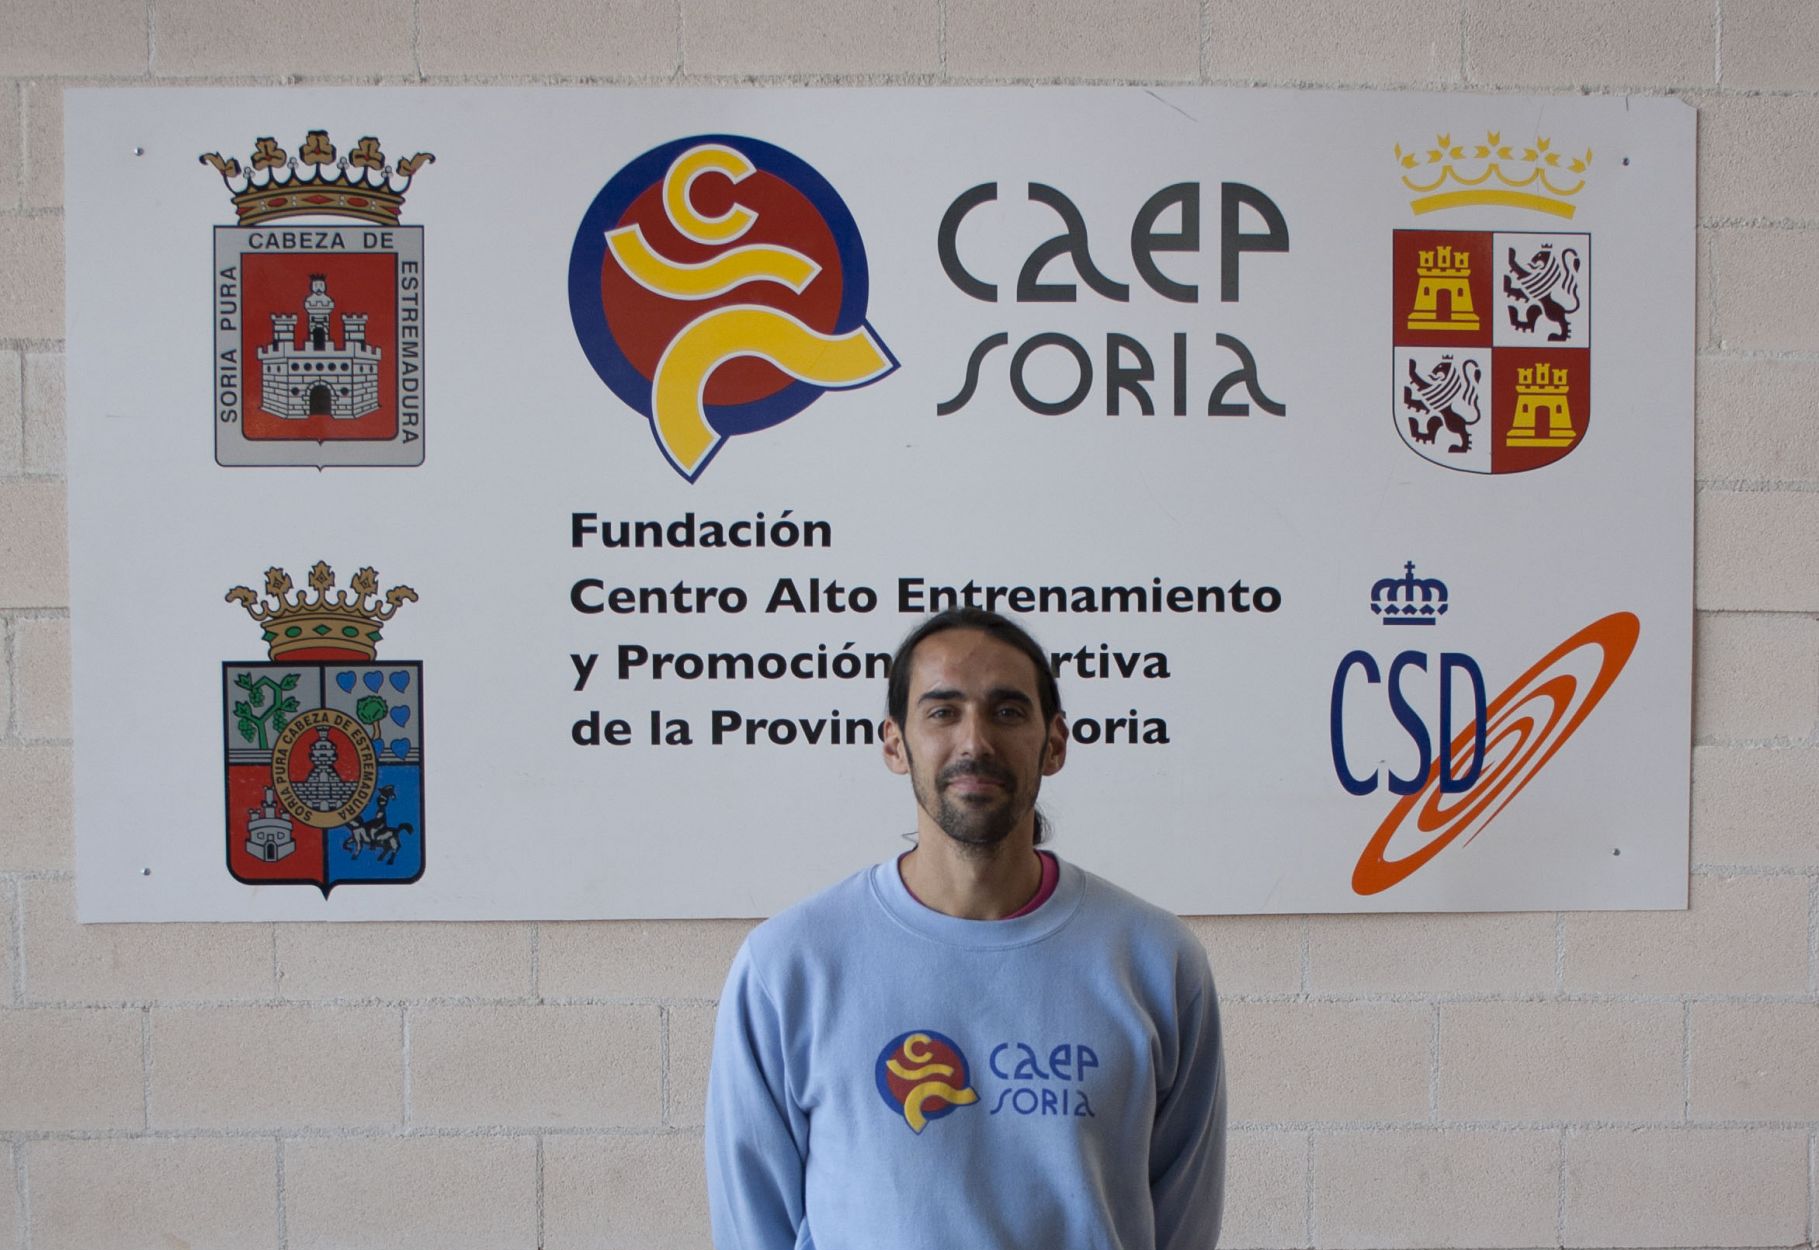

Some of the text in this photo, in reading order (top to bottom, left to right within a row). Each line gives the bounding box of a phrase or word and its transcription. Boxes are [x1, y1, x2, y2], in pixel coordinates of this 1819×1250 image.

[248, 231, 394, 250] CABEZA DE
[219, 265, 238, 424] SORIA PURA
[401, 260, 420, 445] ESTREMADURA
[570, 509, 832, 548] Fundación
[570, 576, 1282, 615] Centro Alto Entrenamiento
[570, 641, 1171, 692] y Promoción rtiva
[571, 708, 1171, 746] de la Provin oria
[1330, 649, 1487, 796] CSD
[275, 711, 374, 822] SORIA PURA CABEZA DE ESTREMADURA
